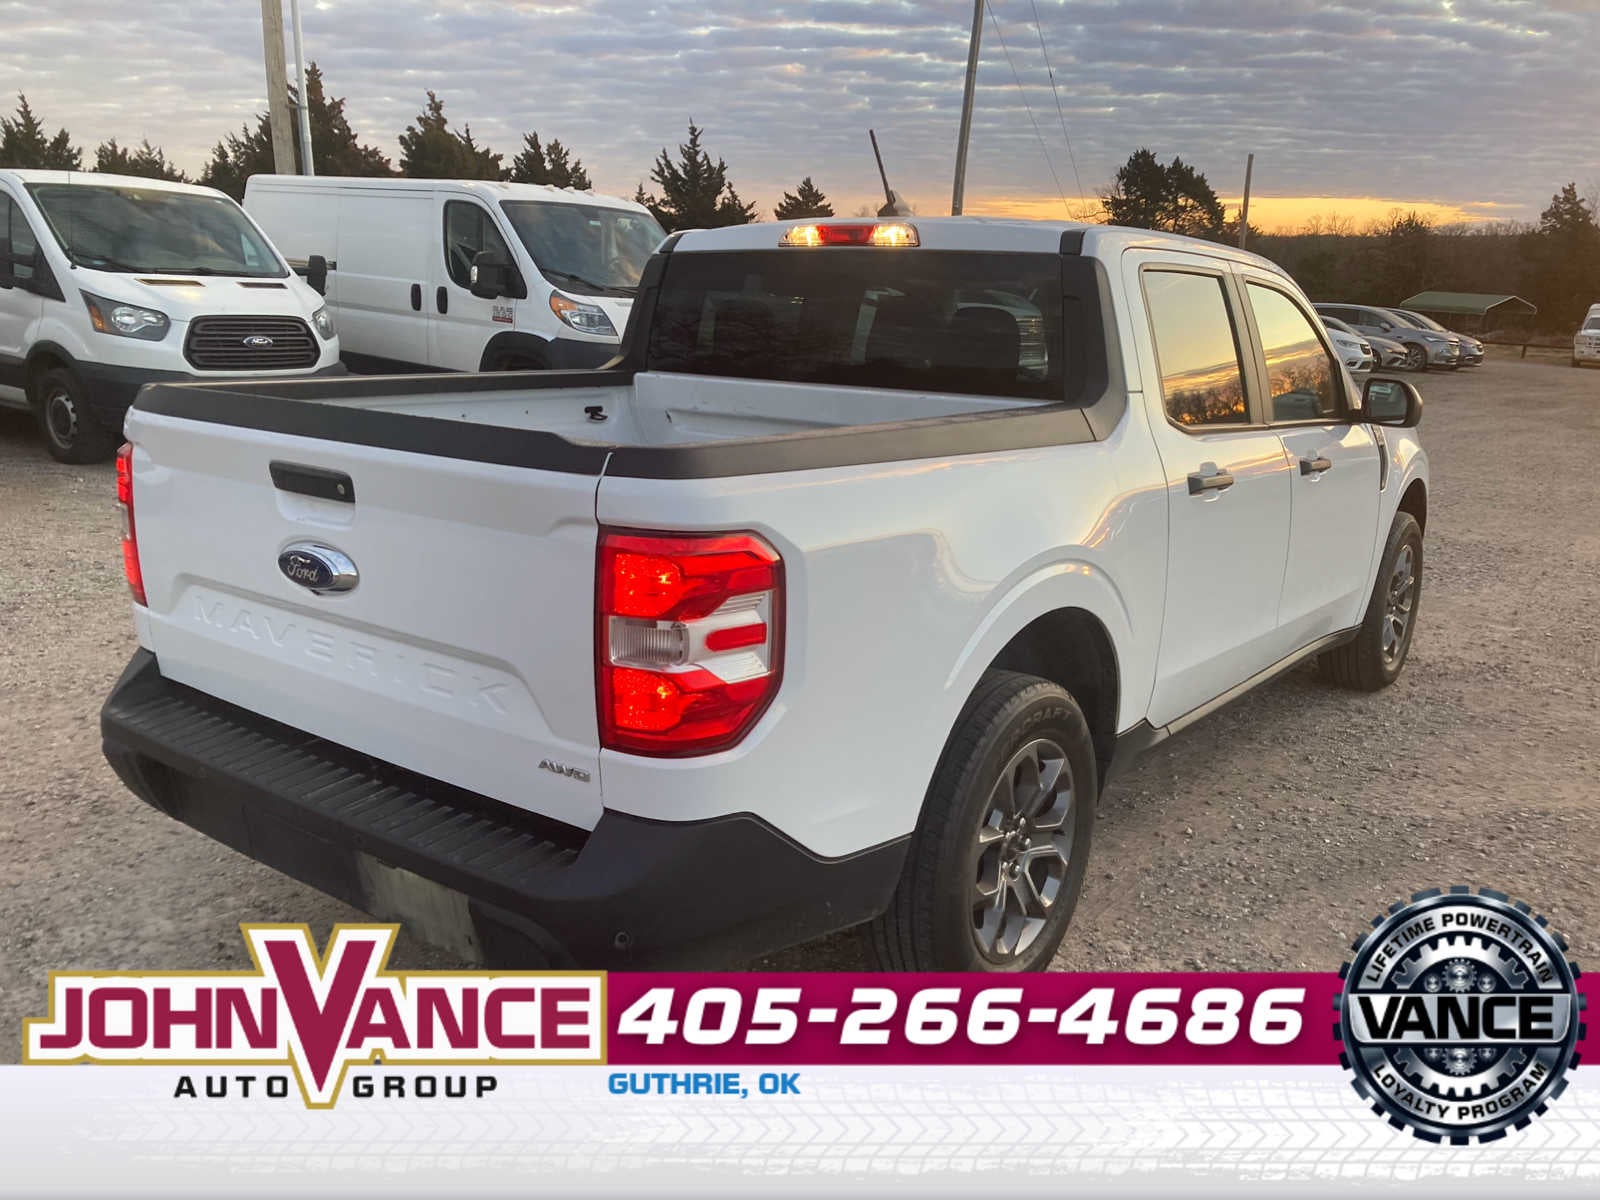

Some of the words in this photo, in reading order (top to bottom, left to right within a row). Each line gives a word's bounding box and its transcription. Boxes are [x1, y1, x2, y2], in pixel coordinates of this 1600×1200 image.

[287, 555, 320, 583] Ford
[193, 596, 509, 716] MAVERICK
[538, 759, 591, 782] AWD
